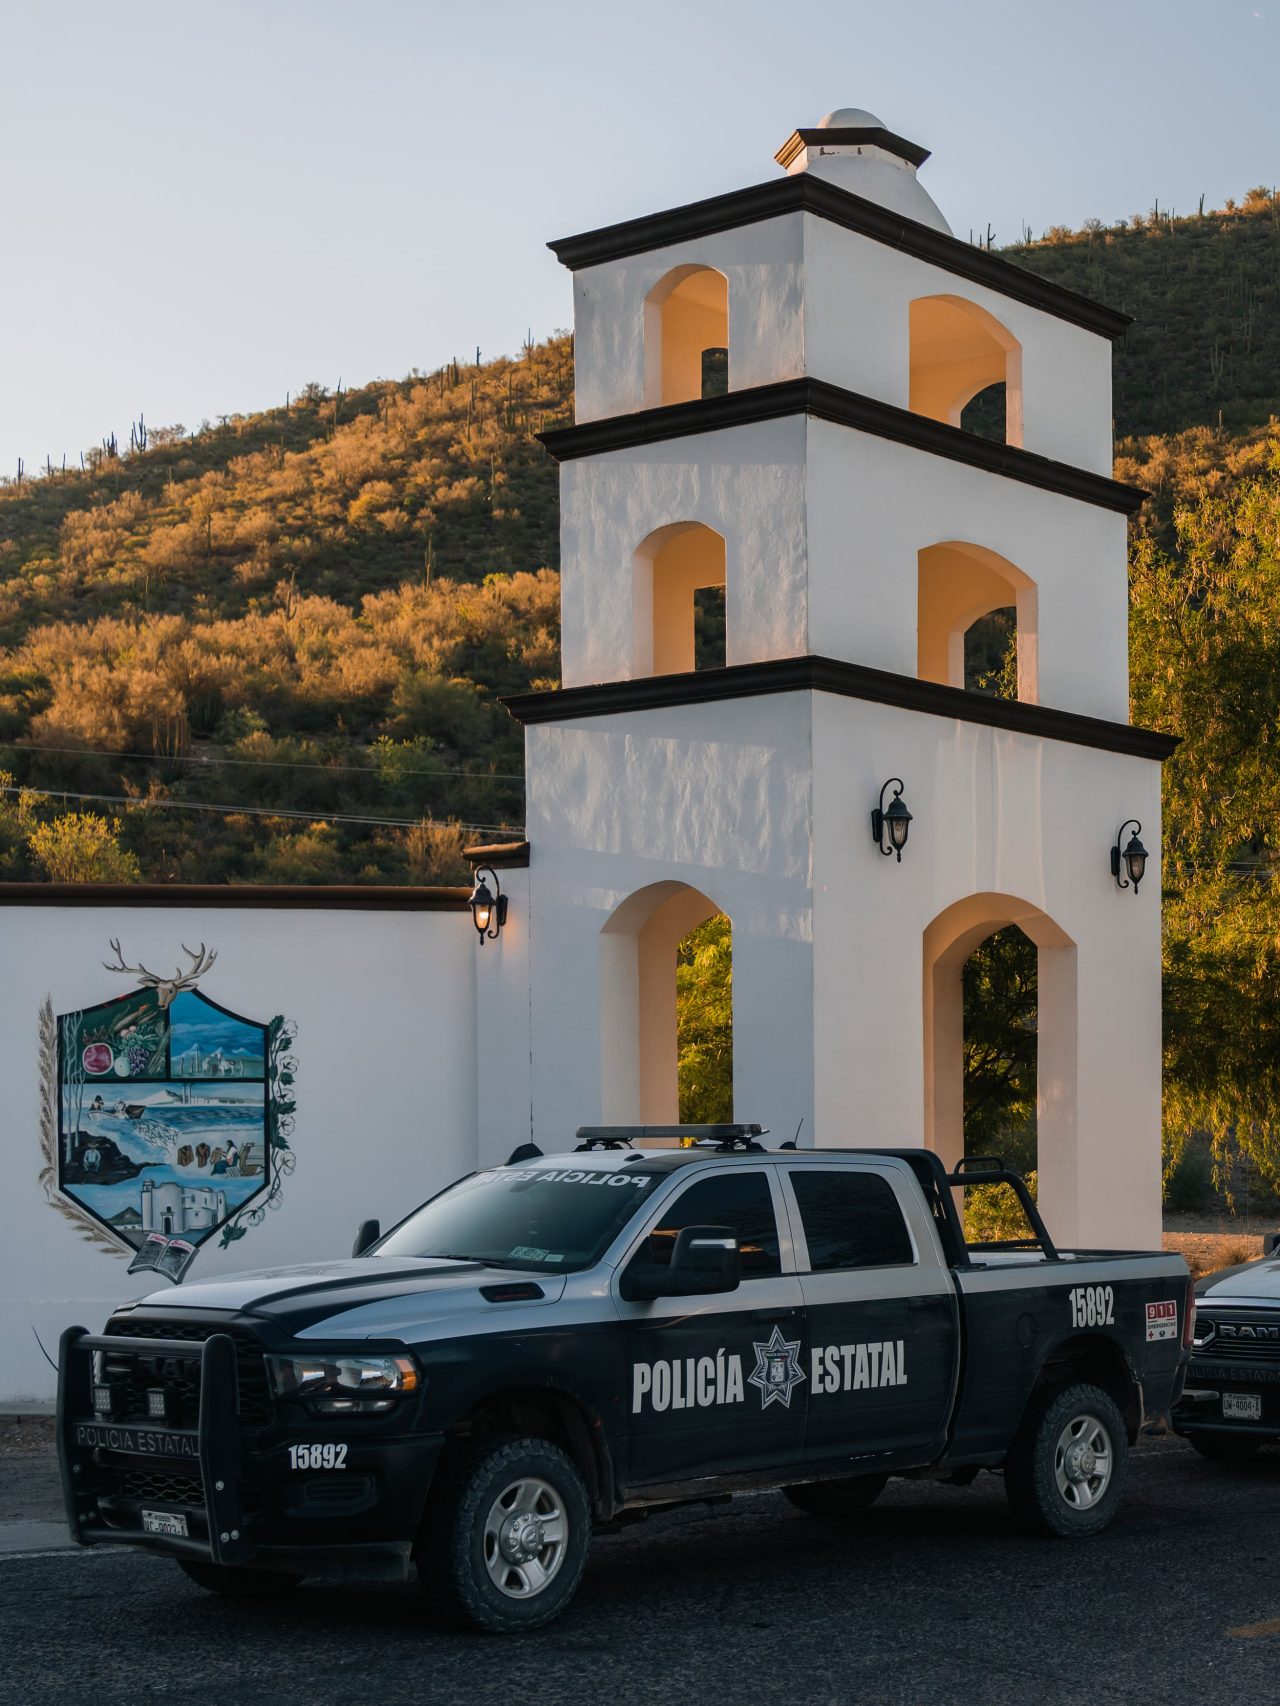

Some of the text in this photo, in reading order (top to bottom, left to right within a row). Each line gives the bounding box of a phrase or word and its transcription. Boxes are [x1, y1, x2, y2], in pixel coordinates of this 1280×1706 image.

[1069, 1285, 1115, 1328] 15892
[1149, 1303, 1174, 1318] 911
[1219, 1325, 1279, 1338] RAM
[632, 1339, 908, 1414] POLICÍA ESTATAL
[77, 1426, 200, 1456] POLICIA ESTATAL
[288, 1444, 348, 1469] 15892
